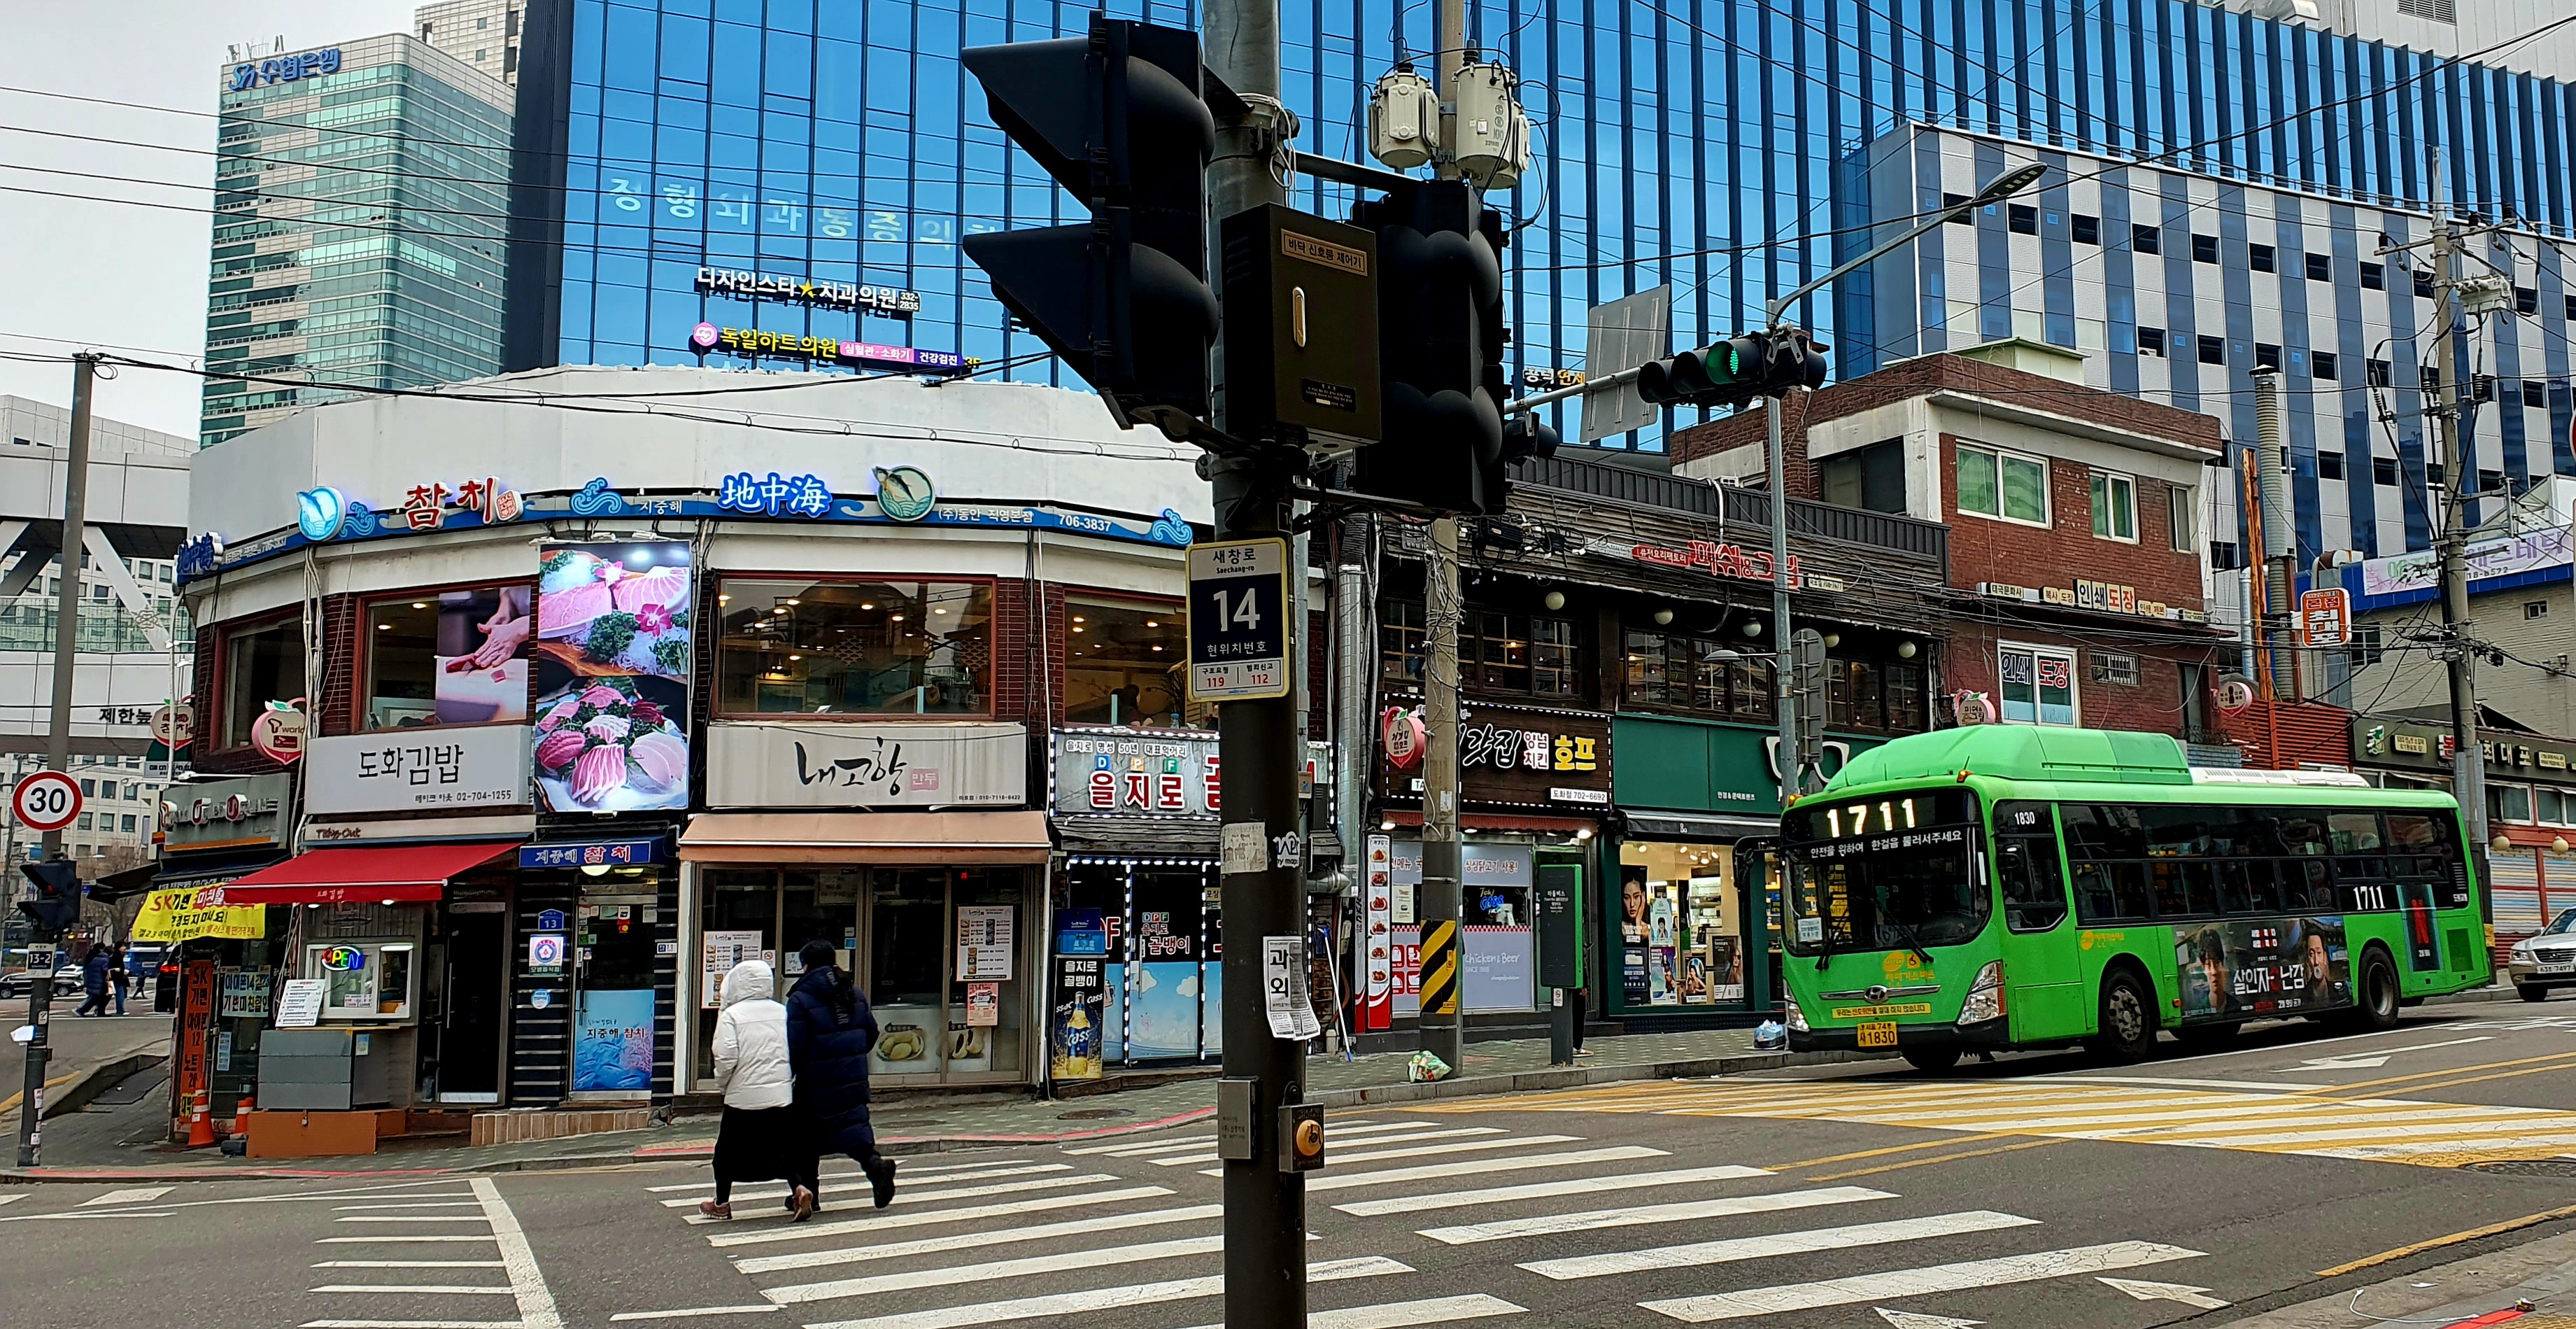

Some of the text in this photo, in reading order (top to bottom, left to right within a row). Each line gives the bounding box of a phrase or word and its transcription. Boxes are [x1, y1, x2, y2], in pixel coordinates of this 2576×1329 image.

[260, 48, 341, 84] 수협은행
[1288, 238, 1361, 269] 바닥 신호등 제어기
[698, 267, 897, 309] 디자인스타 치과의원
[899, 300, 919, 311] 2835
[720, 326, 837, 358] 독일하트의원
[919, 351, 958, 365] 건강검진
[404, 476, 495, 530] 참치
[722, 474, 830, 515] 地中海
[639, 500, 683, 516] 지중해
[937, 507, 982, 522] (주)동안
[1058, 513, 1112, 533] 706-3837
[1212, 547, 1257, 564] 새창로
[1216, 565, 1255, 575] Saechang-ro
[1992, 584, 2022, 598] 태극문화사
[2045, 590, 2058, 601] 복사
[2060, 593, 2074, 603] 도장
[1212, 587, 1261, 632] 14
[1207, 640, 1267, 657] 현위치번호
[1202, 666, 1229, 675] 구조요청
[1246, 663, 1273, 672] 범죄신고
[2001, 653, 2069, 689] 인쇄 도장
[1207, 677, 1225, 688] 119
[1251, 674, 1269, 684] 112
[1066, 740, 1093, 753] 을지로
[1096, 741, 1115, 754] 명성
[1119, 743, 1139, 755] 50년
[1555, 735, 1597, 771] 호프
[2484, 739, 2531, 766] 최대포
[358, 743, 465, 786] 도화김밥
[794, 736, 937, 796] 내고향 만두
[1096, 757, 1176, 771] D P F
[1524, 751, 1548, 769] 치킨
[456, 790, 512, 801] 02-704-1255
[1089, 771, 1185, 810] 을지로
[1552, 789, 1606, 801] 도화점 702-6692
[29, 787, 66, 813] 30
[1827, 799, 1916, 838] 1711
[2014, 811, 2035, 825] 1830
[1811, 831, 1962, 859] 안전을 위하여 한걸음 물러서주세요
[583, 845, 631, 864] 참치
[1501, 859, 1519, 873] 사용!
[2353, 885, 2386, 910] 1711
[544, 920, 558, 929] 13
[1141, 923, 1169, 936] 을지로
[1148, 936, 1190, 955] 골뱅이
[29, 953, 51, 964] 13-2
[322, 948, 363, 970] OPEN
[1066, 960, 1098, 973] 을지로
[1501, 952, 1521, 964] Beer
[192, 966, 208, 984] SK
[1064, 974, 1097, 987] 골뱅이
[192, 1032, 201, 1047] 12
[587, 1027, 646, 1039] 지중해 참치
